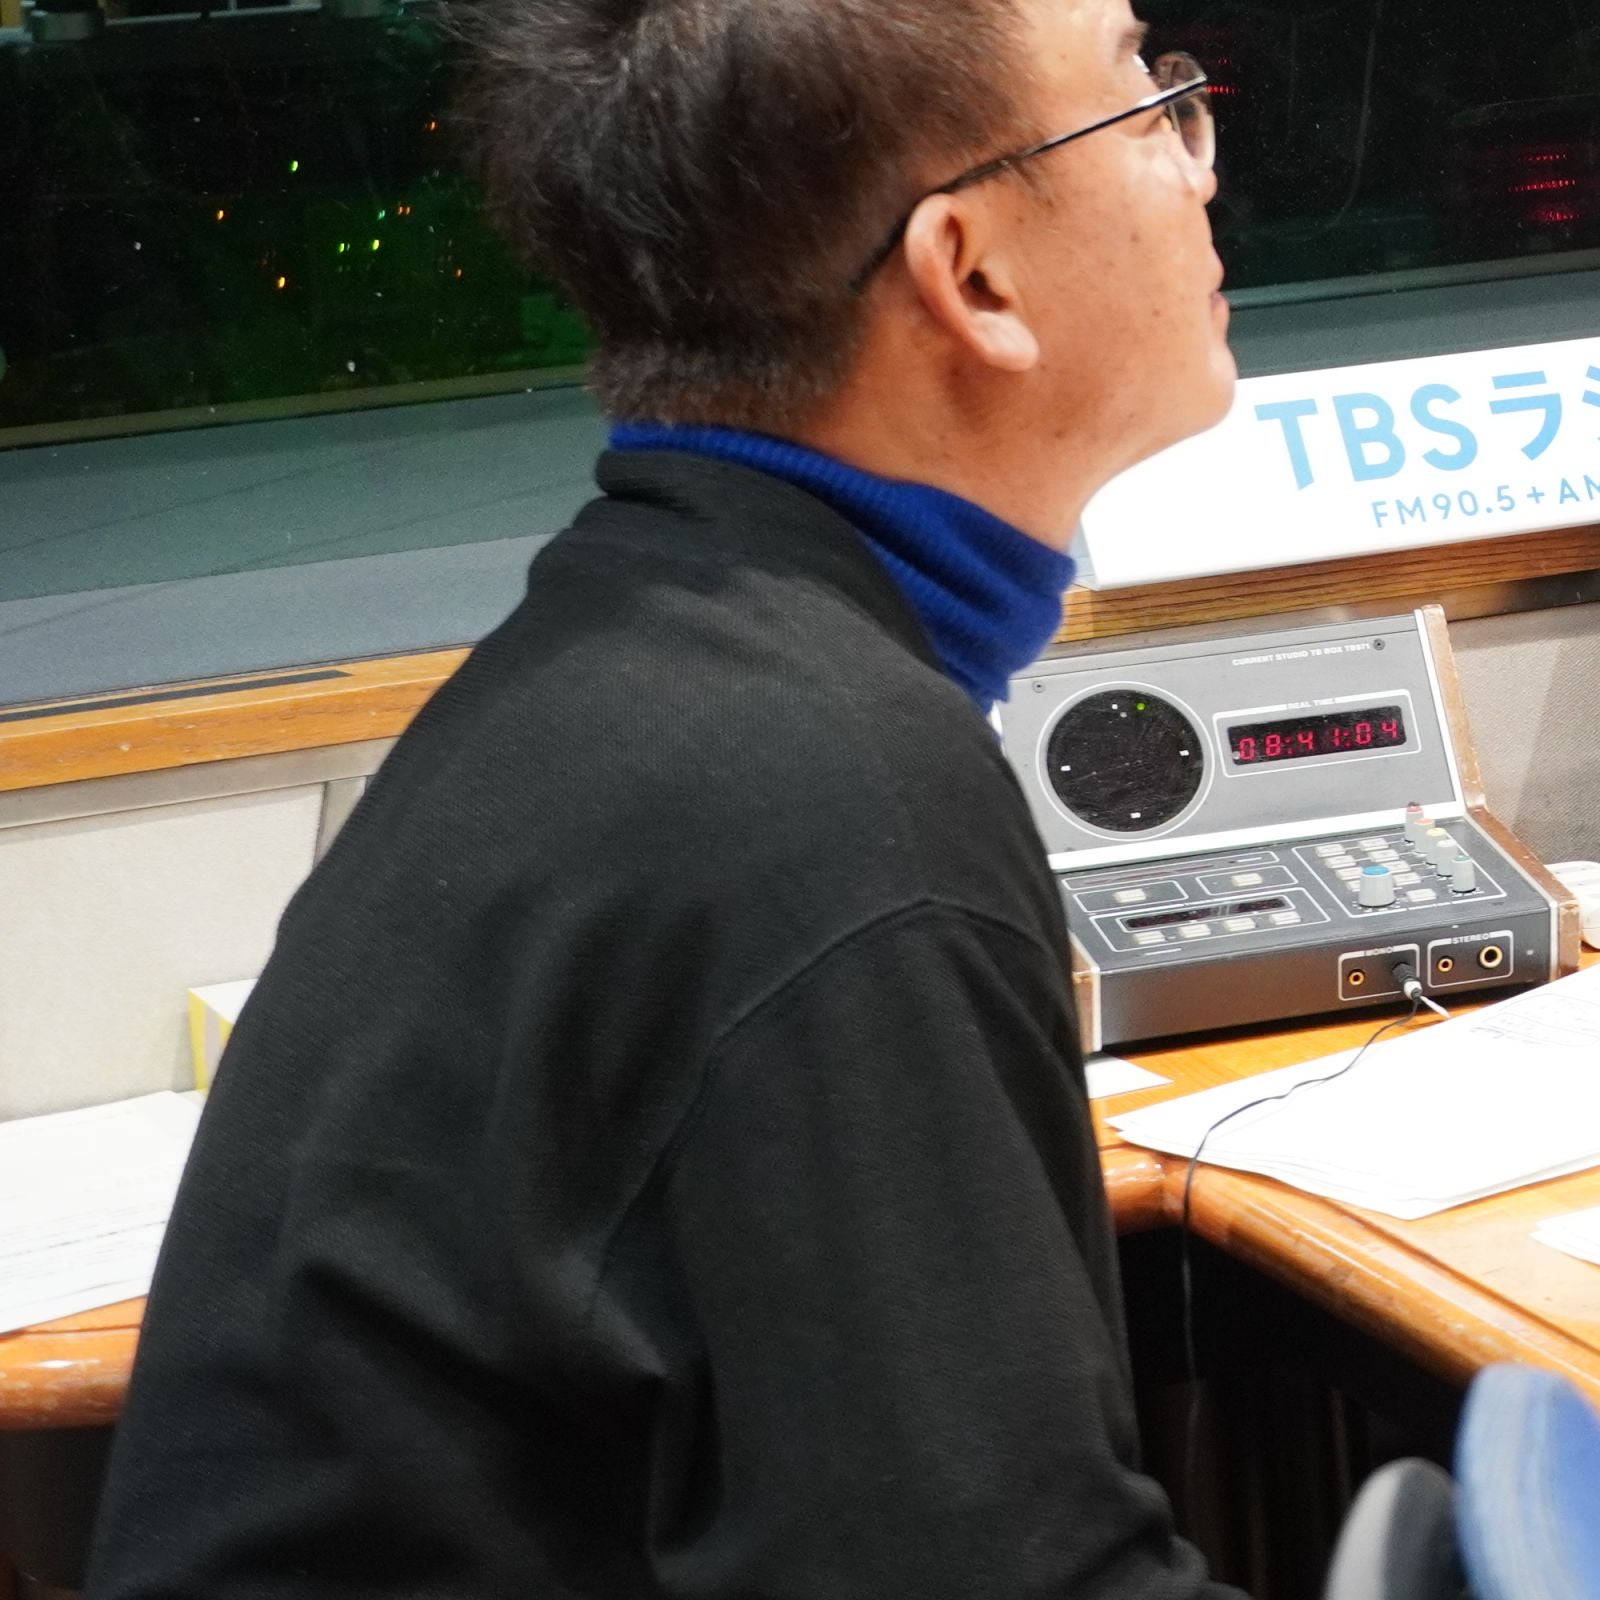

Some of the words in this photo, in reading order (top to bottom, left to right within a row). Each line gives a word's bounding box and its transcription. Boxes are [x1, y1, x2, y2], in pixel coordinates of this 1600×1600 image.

[1275, 650, 1308, 662] STUDIO
[1238, 719, 1398, 761] 08:41:04
[1451, 931, 1490, 946] STEREO
